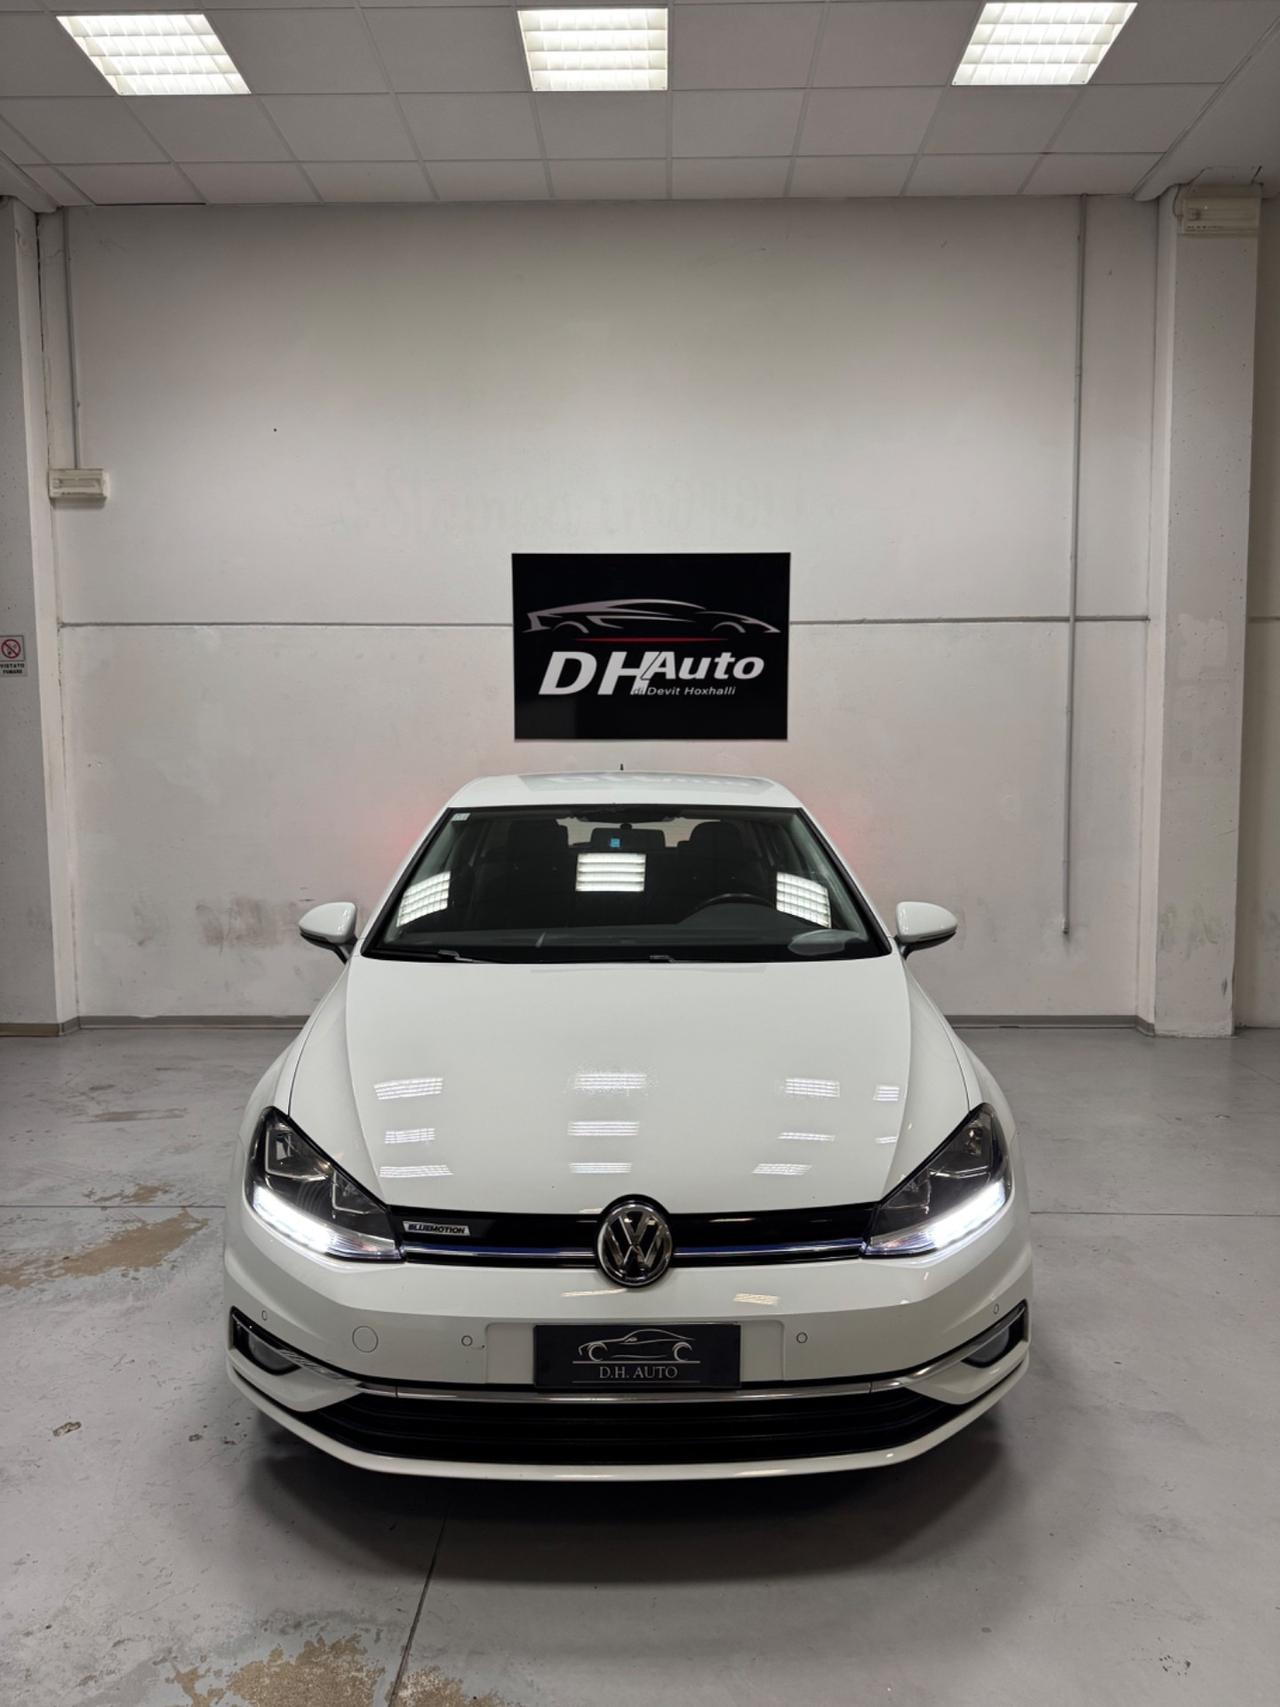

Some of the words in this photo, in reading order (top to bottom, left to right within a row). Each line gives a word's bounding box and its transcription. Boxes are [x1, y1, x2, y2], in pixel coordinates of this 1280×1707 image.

[647, 686, 680, 696] Devit
[684, 686, 736, 696] Hoxhalli
[408, 1223, 465, 1234] BLUEMOTION
[599, 1366, 629, 1378] D.H.
[634, 1366, 678, 1378] AUTO
